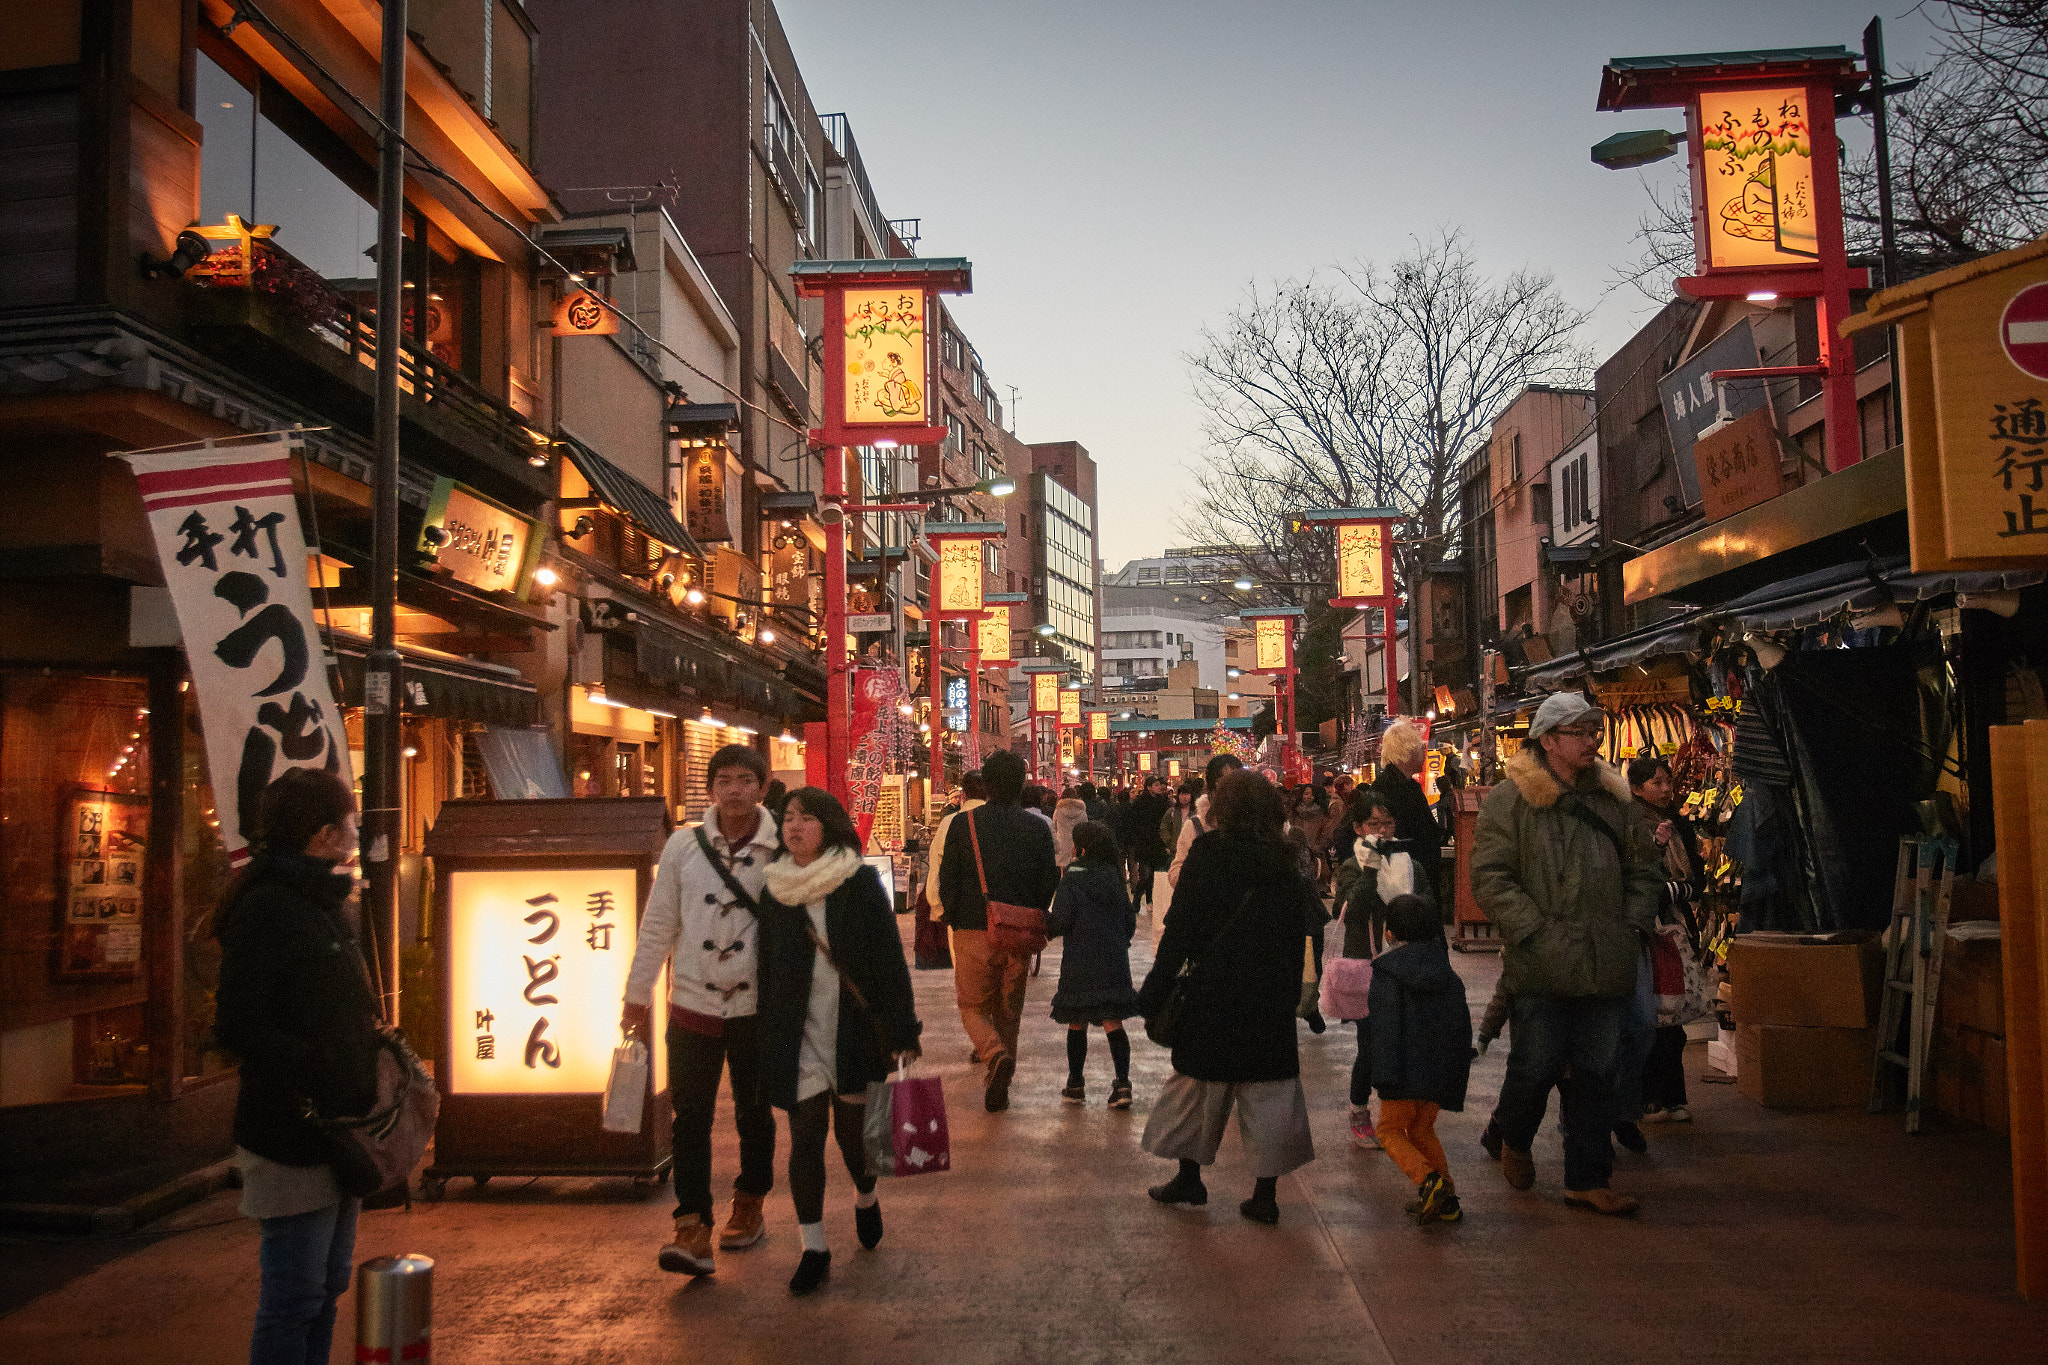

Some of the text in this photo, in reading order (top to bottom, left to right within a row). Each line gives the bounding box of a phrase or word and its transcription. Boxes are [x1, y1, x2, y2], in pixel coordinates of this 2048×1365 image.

[1752, 108, 1772, 147] もの
[1989, 398, 2048, 538] 通行止
[176, 505, 288, 578] 手打
[849, 732, 870, 827] ご遠慮くださ
[586, 890, 615, 950] 手打
[523, 892, 562, 1069] うどん
[475, 1008, 495, 1060] 叶屋
